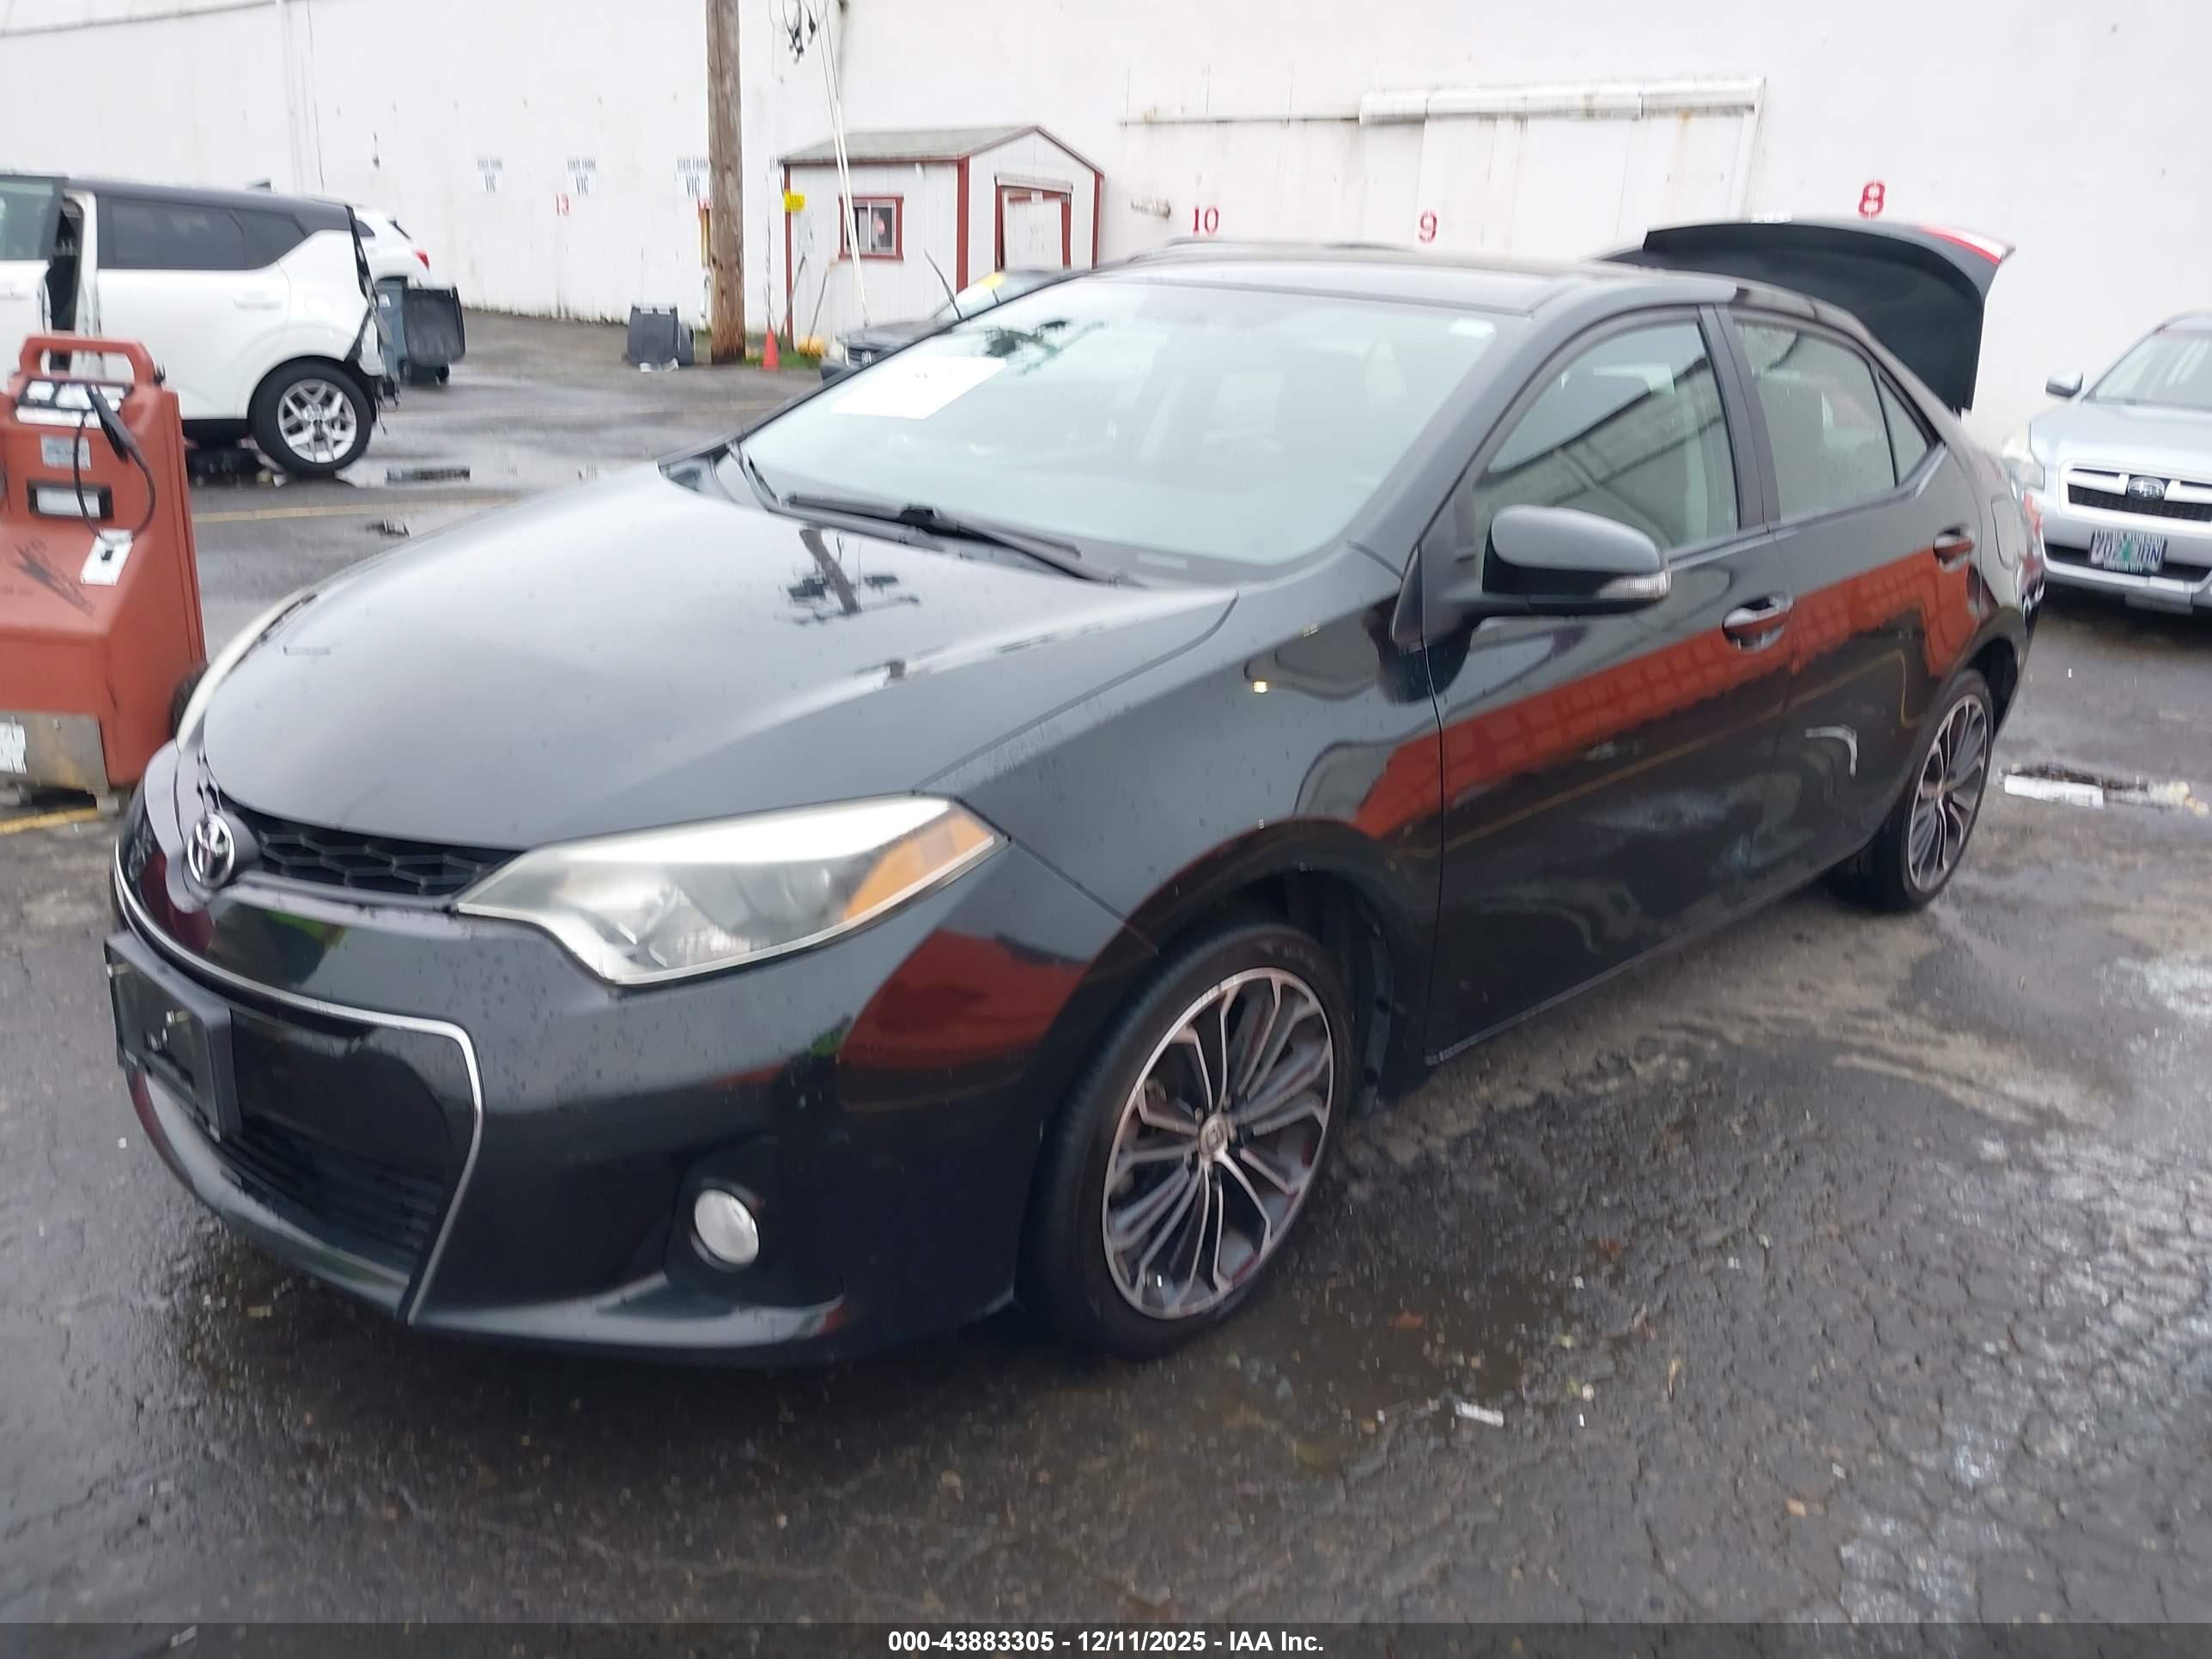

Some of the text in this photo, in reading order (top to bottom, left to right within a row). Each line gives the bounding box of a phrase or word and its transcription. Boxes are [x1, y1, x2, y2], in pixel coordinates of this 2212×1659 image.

[575, 174, 589, 196] VIC
[1857, 181, 1886, 219] 8
[556, 192, 569, 216] 13
[1193, 205, 1219, 235] 10
[1419, 211, 1437, 242] 9
